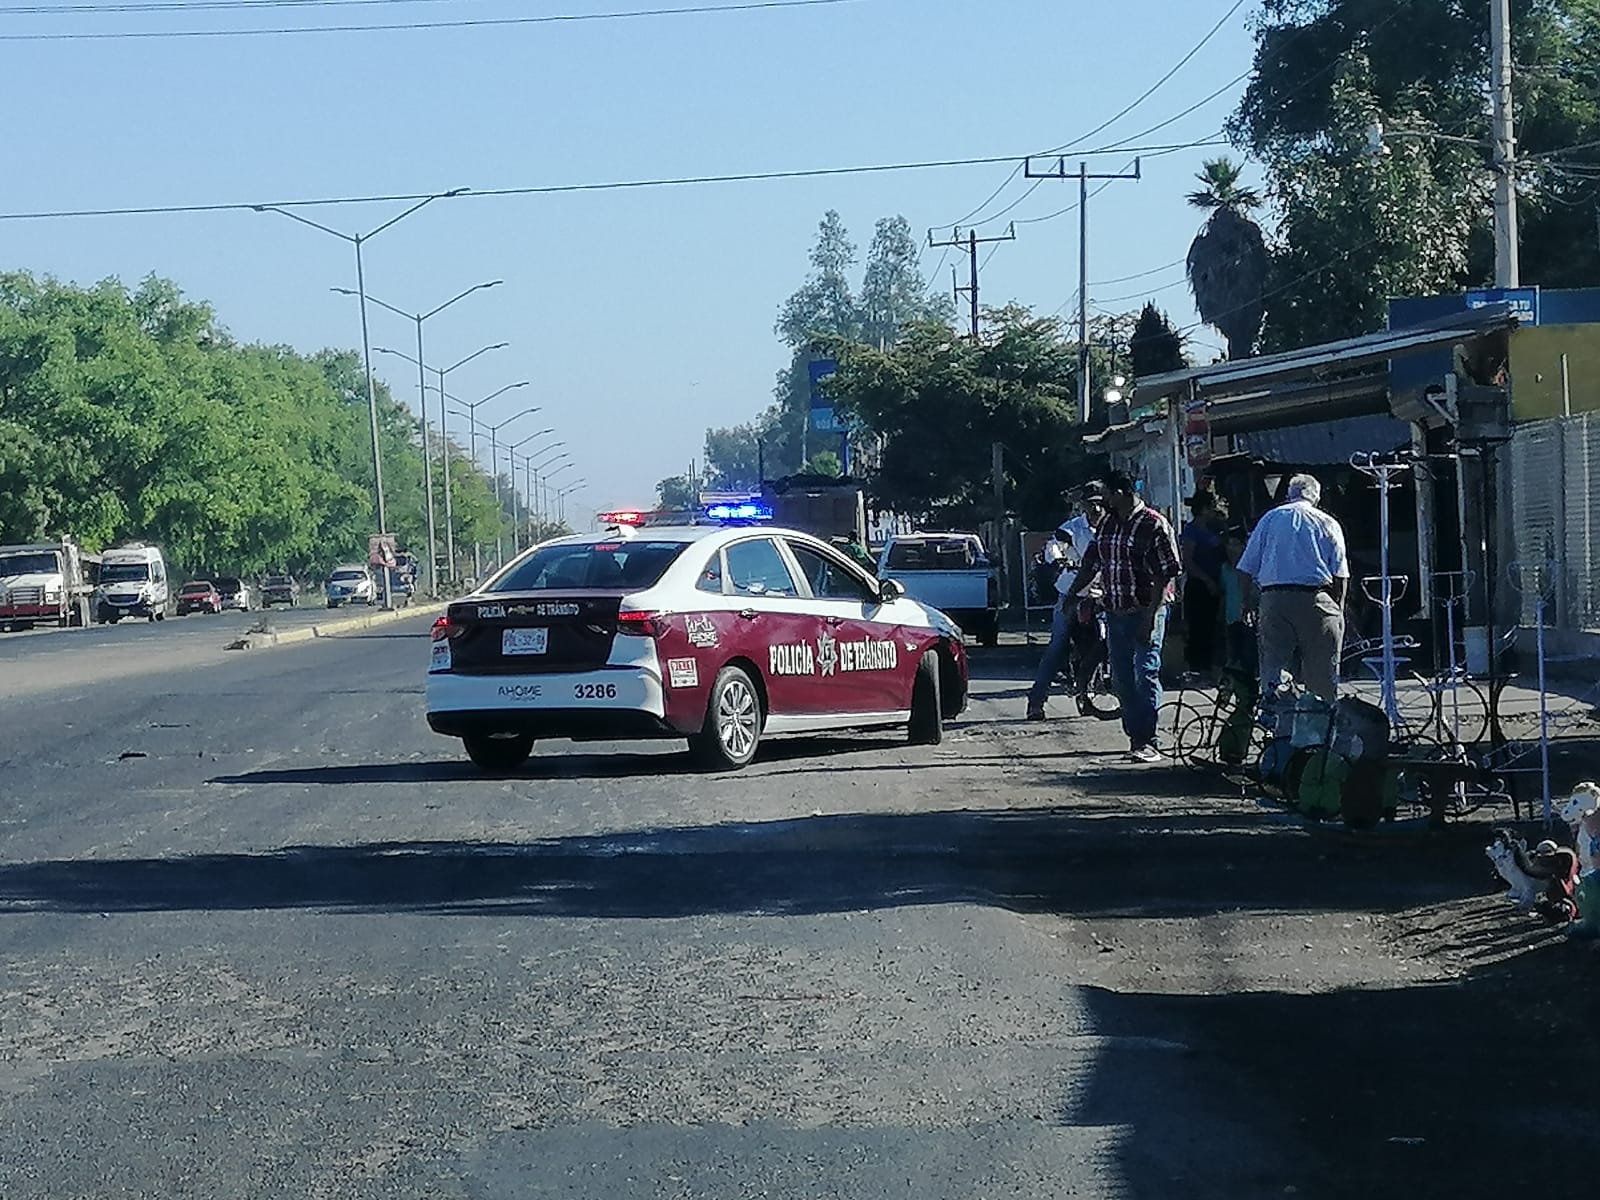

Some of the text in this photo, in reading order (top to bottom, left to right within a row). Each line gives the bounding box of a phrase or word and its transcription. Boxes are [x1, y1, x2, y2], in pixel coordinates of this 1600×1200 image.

[769, 636, 897, 675] POLICÍA DE TRÁNSITO
[498, 683, 617, 699] AHOME 3286
